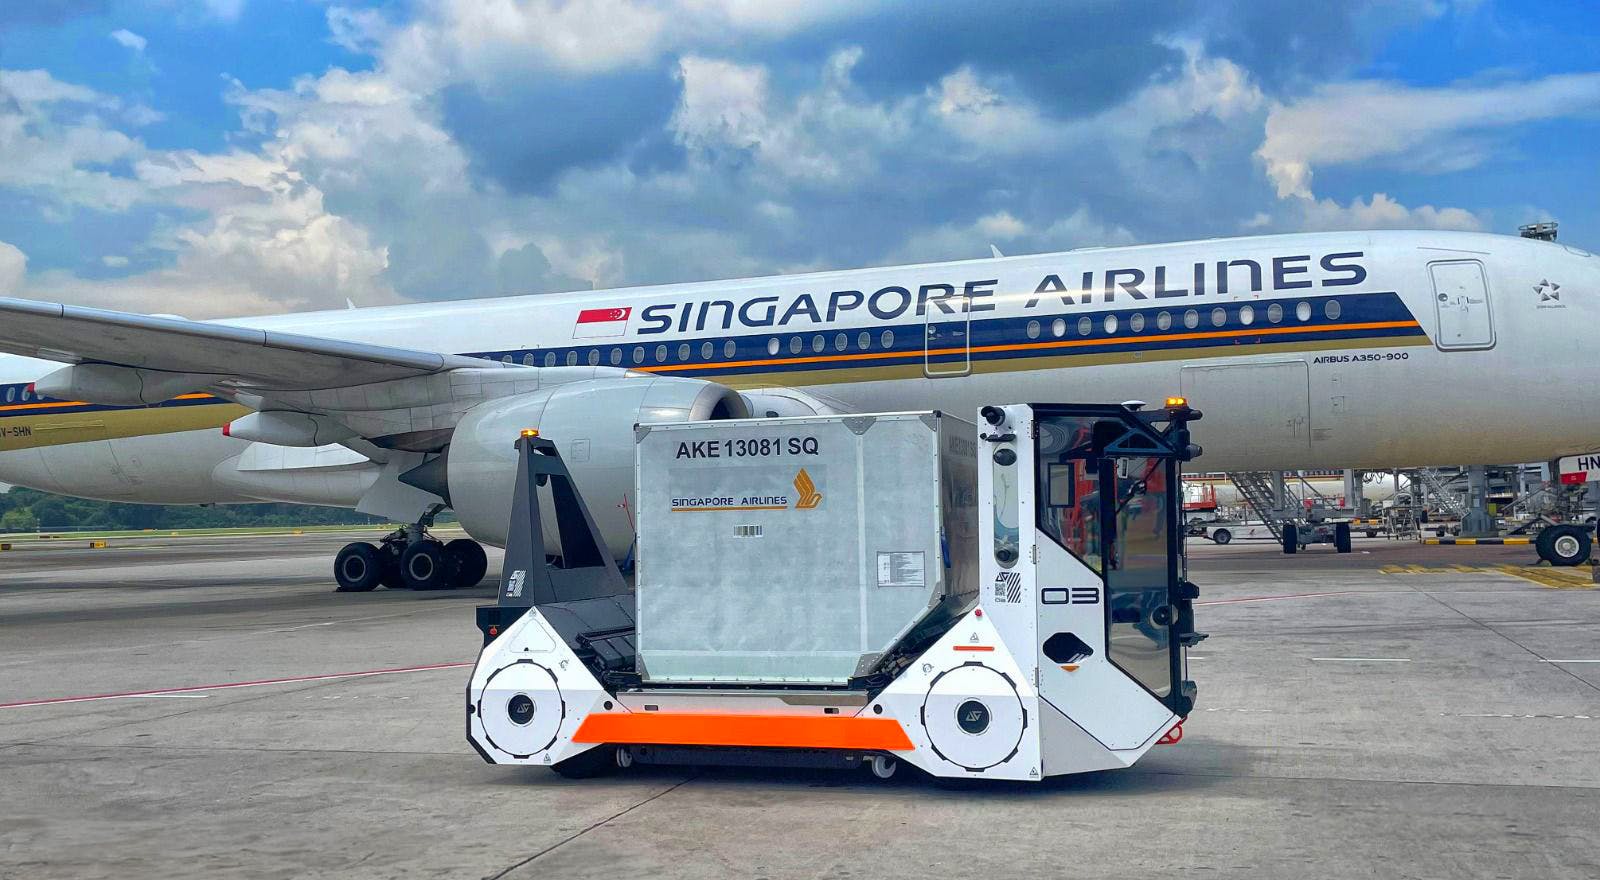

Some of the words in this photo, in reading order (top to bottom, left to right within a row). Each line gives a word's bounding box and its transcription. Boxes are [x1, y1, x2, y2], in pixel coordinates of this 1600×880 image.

[637, 279, 999, 335] SINGAPORE
[1024, 251, 1367, 308] AIRLINES
[1313, 355, 1350, 364] AIRBUS
[1352, 352, 1409, 362] A350-900
[0, 426, 32, 437] V-SHN
[676, 440, 720, 459] AKE
[724, 438, 781, 457] 13081
[788, 436, 819, 456] SQ
[672, 497, 734, 507] SINGAPORE
[741, 496, 787, 505] AIRLINES
[1041, 587, 1100, 604] 03
